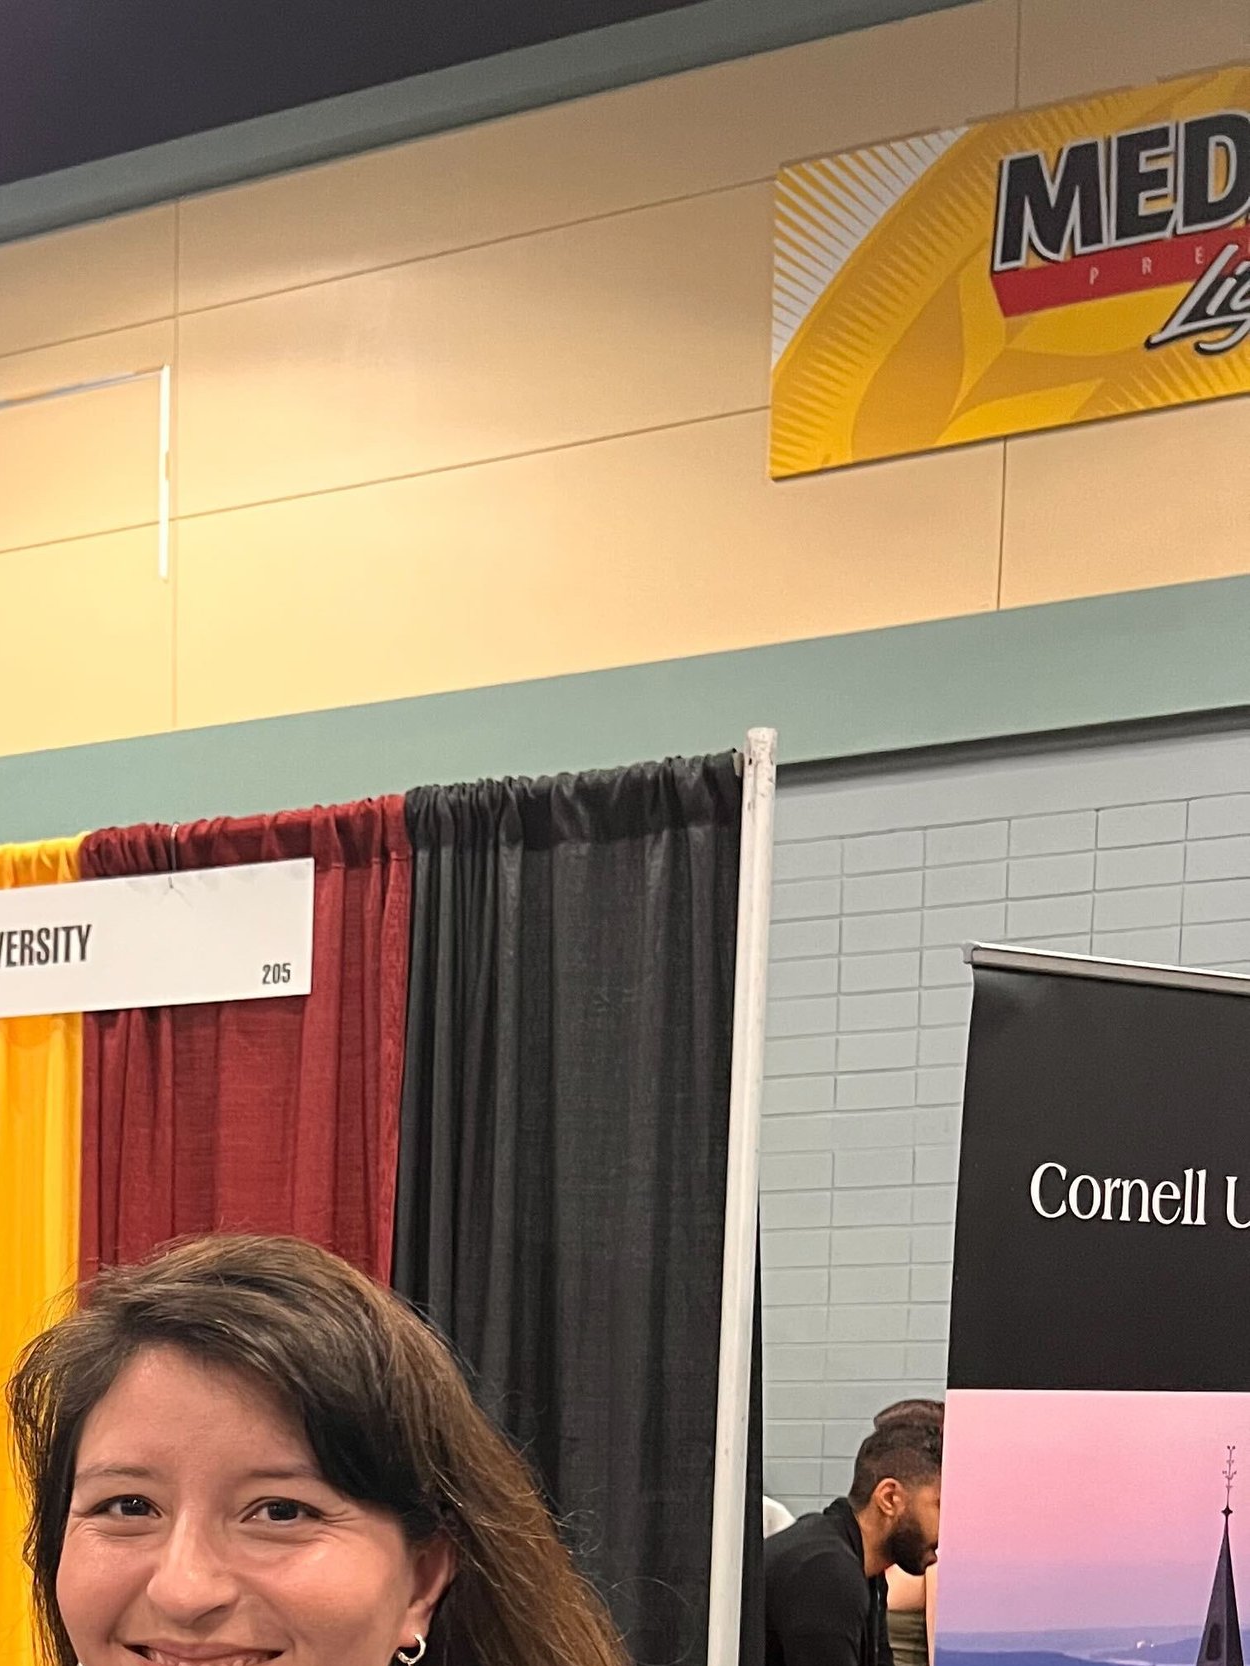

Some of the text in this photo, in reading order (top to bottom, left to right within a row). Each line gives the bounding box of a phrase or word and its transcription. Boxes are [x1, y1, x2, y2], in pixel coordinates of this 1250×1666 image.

[992, 110, 1250, 271] MED
[262, 962, 291, 985] 205
[1030, 1162, 1207, 1226] Cornell
